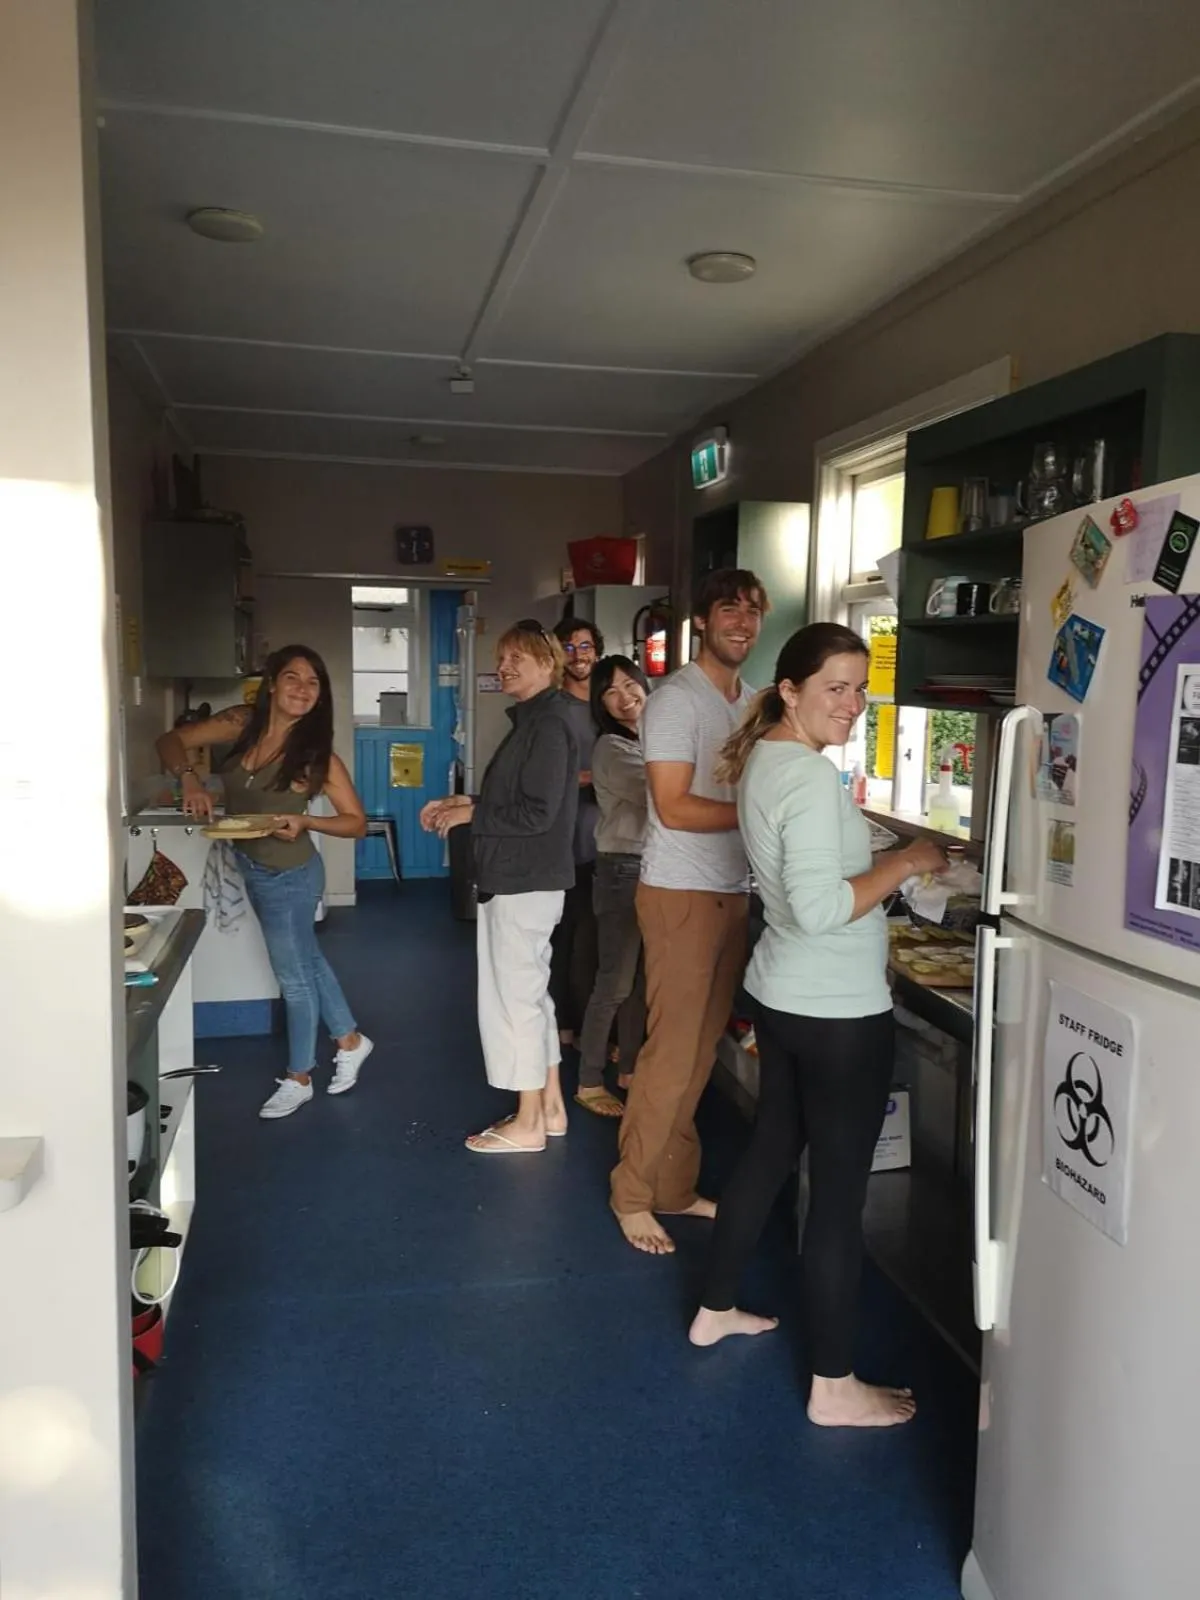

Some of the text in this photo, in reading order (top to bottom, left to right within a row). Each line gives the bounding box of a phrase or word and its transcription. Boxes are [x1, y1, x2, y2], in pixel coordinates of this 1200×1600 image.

[1058, 1013, 1124, 1057] STAFF FRIDGE
[1055, 1157, 1107, 1205] BIOHAZARD
